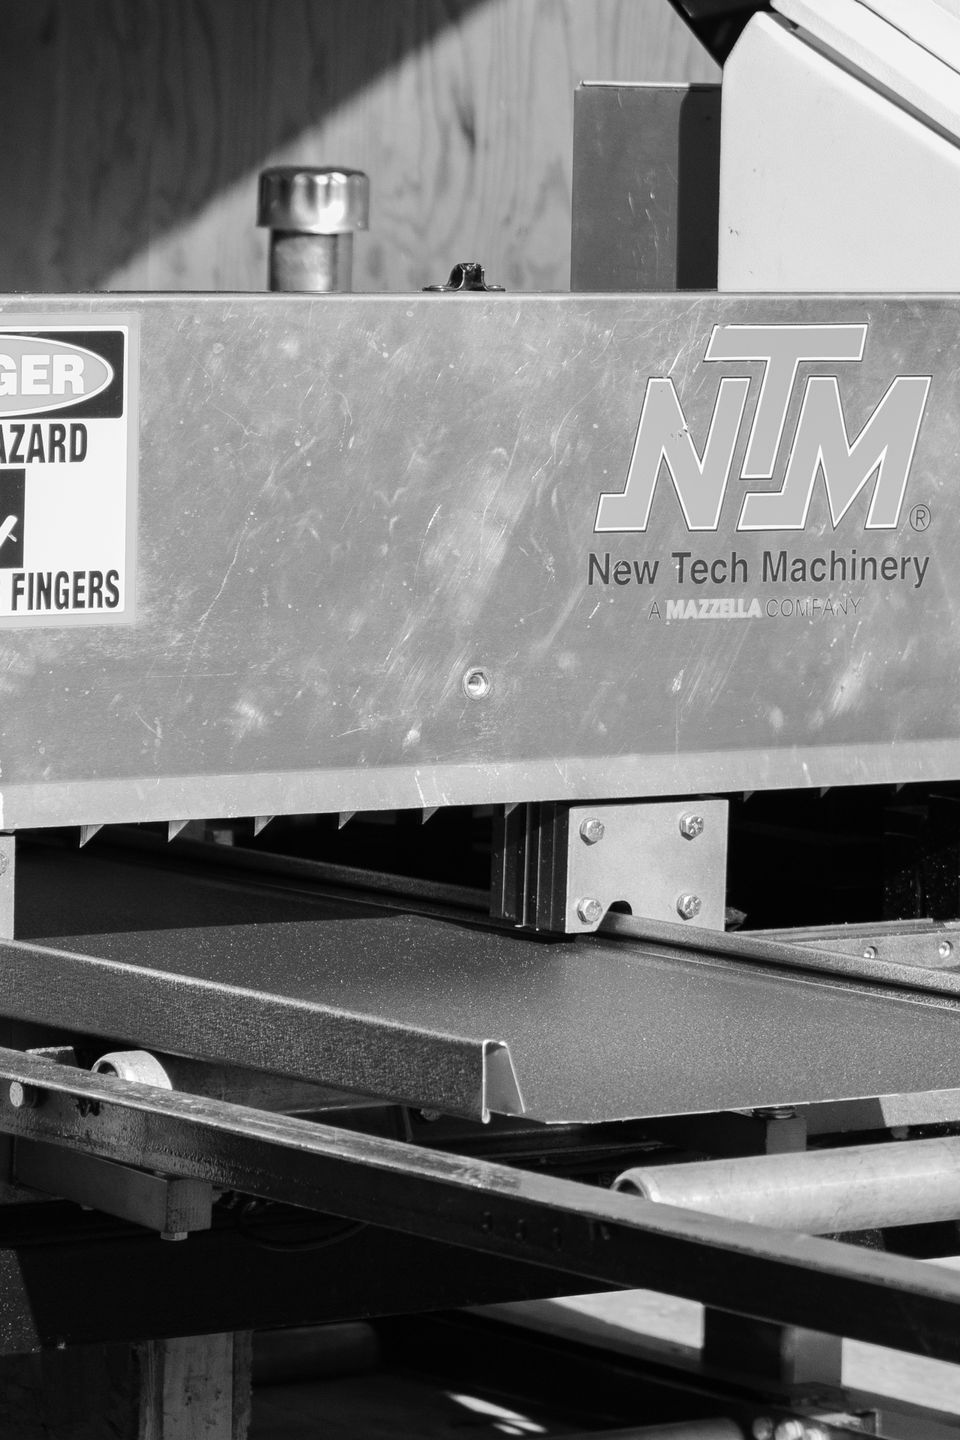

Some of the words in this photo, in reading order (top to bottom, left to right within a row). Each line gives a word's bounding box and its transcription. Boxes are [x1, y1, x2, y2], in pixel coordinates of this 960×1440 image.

[593, 323, 933, 533] NTM
[587, 552, 660, 585] New
[671, 551, 748, 585] Tech
[762, 548, 930, 589] Machinery
[11, 569, 120, 611] FINGERS
[649, 601, 662, 620] A
[665, 598, 763, 620] MAZZELLA
[766, 597, 862, 618] COMPANY
